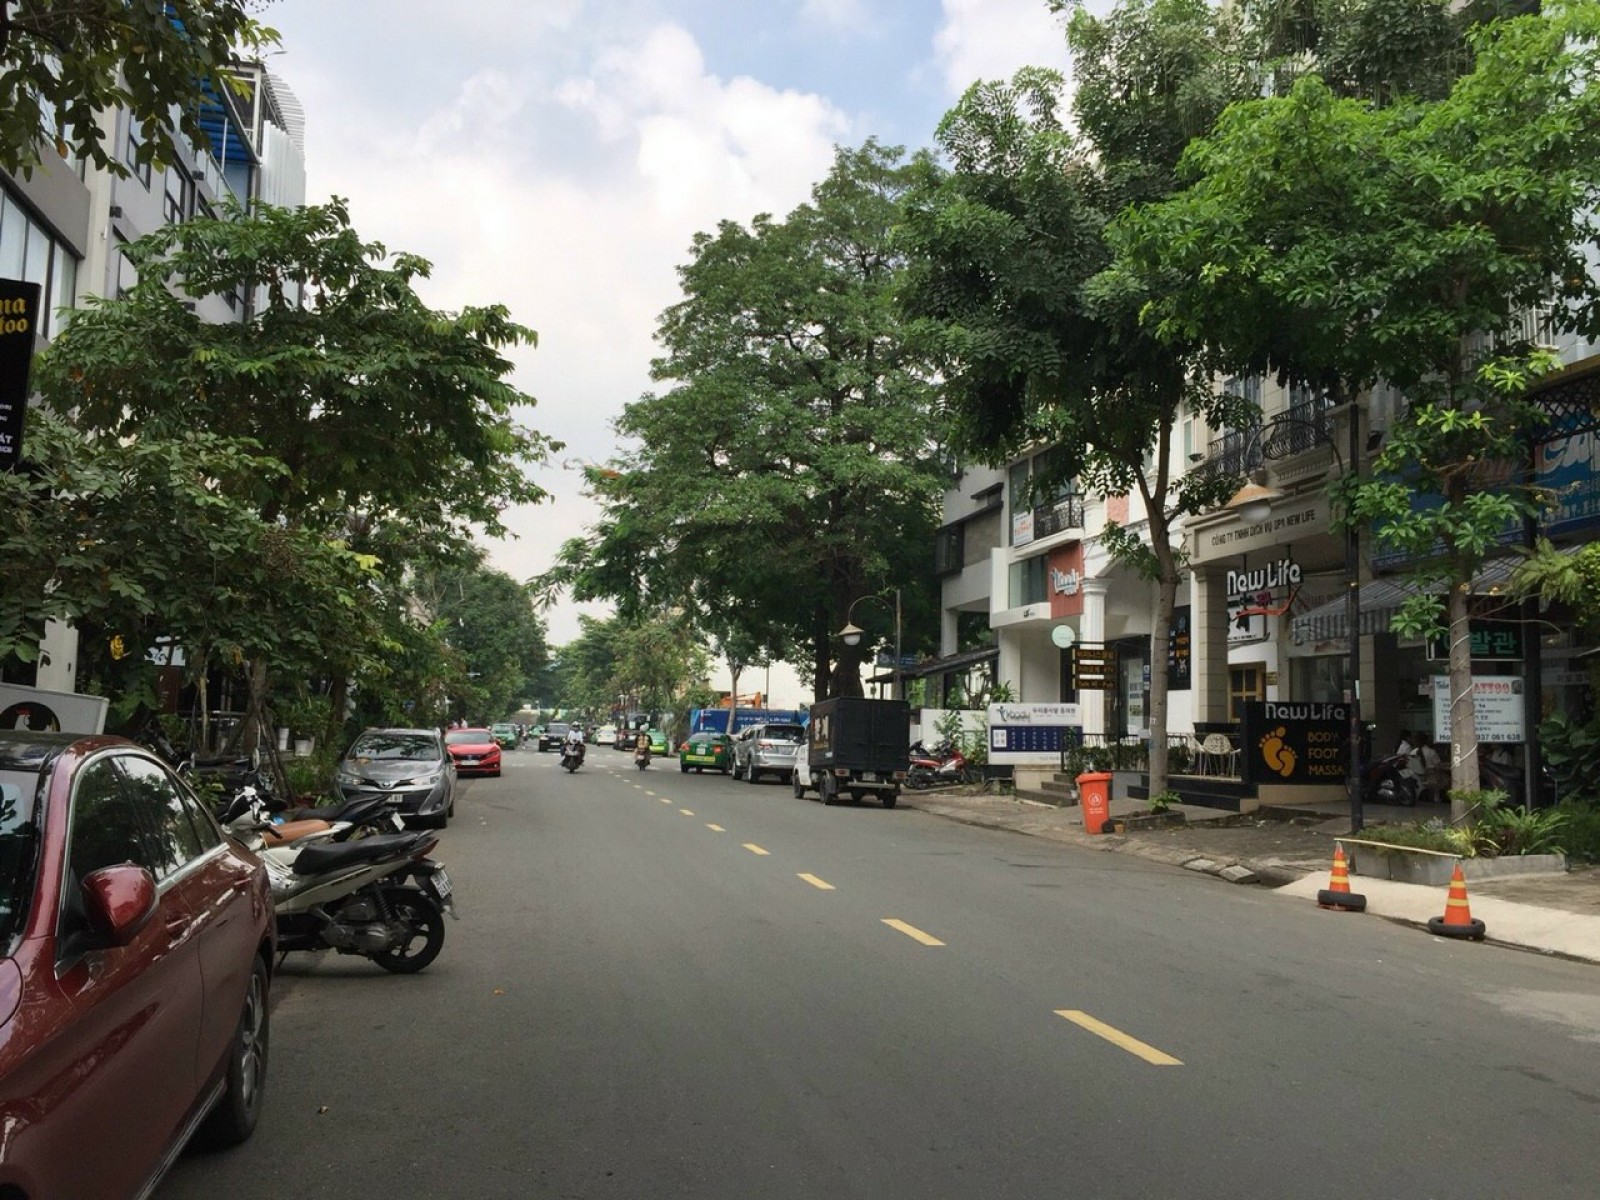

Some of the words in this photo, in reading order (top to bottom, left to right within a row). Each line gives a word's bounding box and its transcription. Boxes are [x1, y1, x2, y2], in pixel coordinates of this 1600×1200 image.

[1286, 513, 1301, 526] NEW
[1301, 509, 1316, 522] LIFE
[1308, 748, 1339, 759] FOOT
